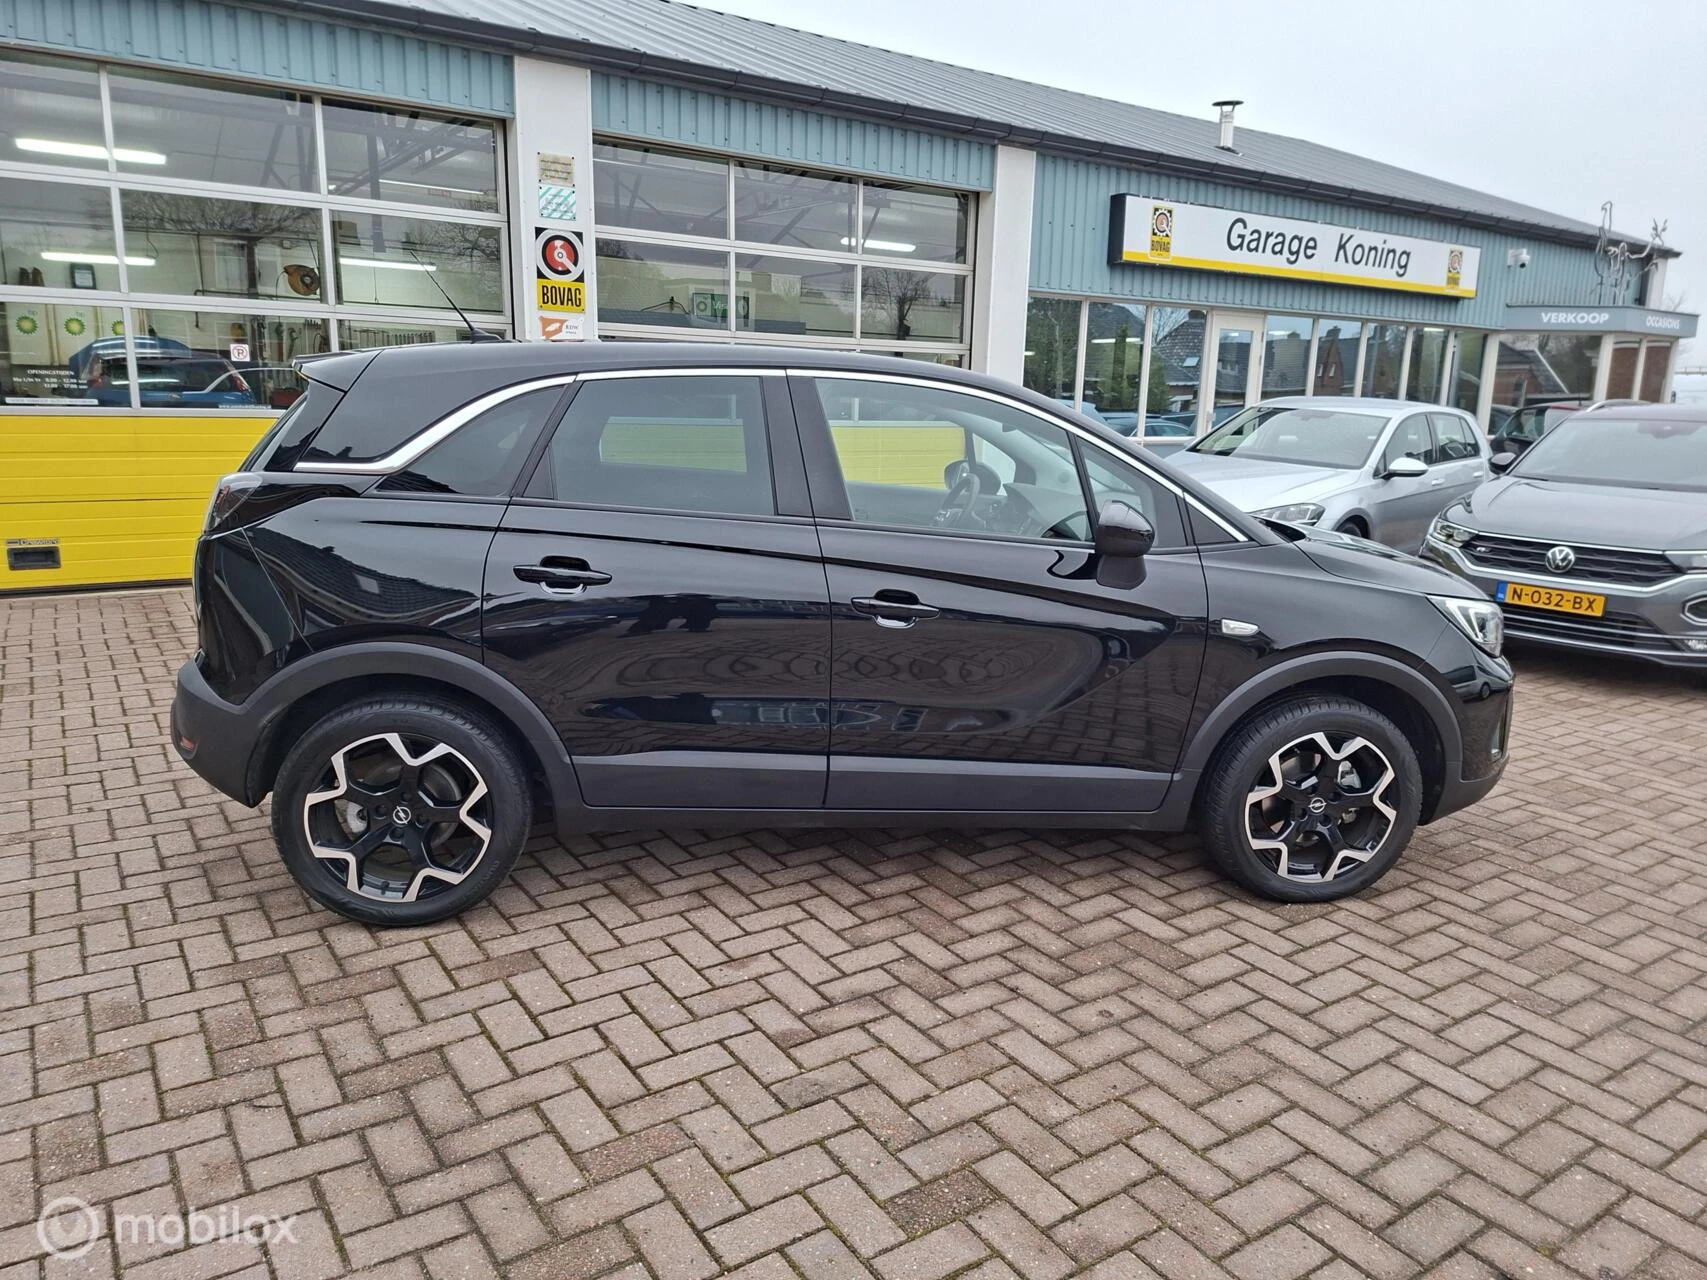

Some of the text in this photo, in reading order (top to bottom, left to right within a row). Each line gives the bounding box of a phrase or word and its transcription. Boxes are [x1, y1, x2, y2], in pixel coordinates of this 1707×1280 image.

[1225, 217, 1412, 278] Garage Koning
[541, 284, 582, 308] BOVAG
[1541, 311, 1610, 325] VERKOOP
[1646, 315, 1681, 330] OCCASIONS
[1511, 586, 1597, 612] N-032-BX
